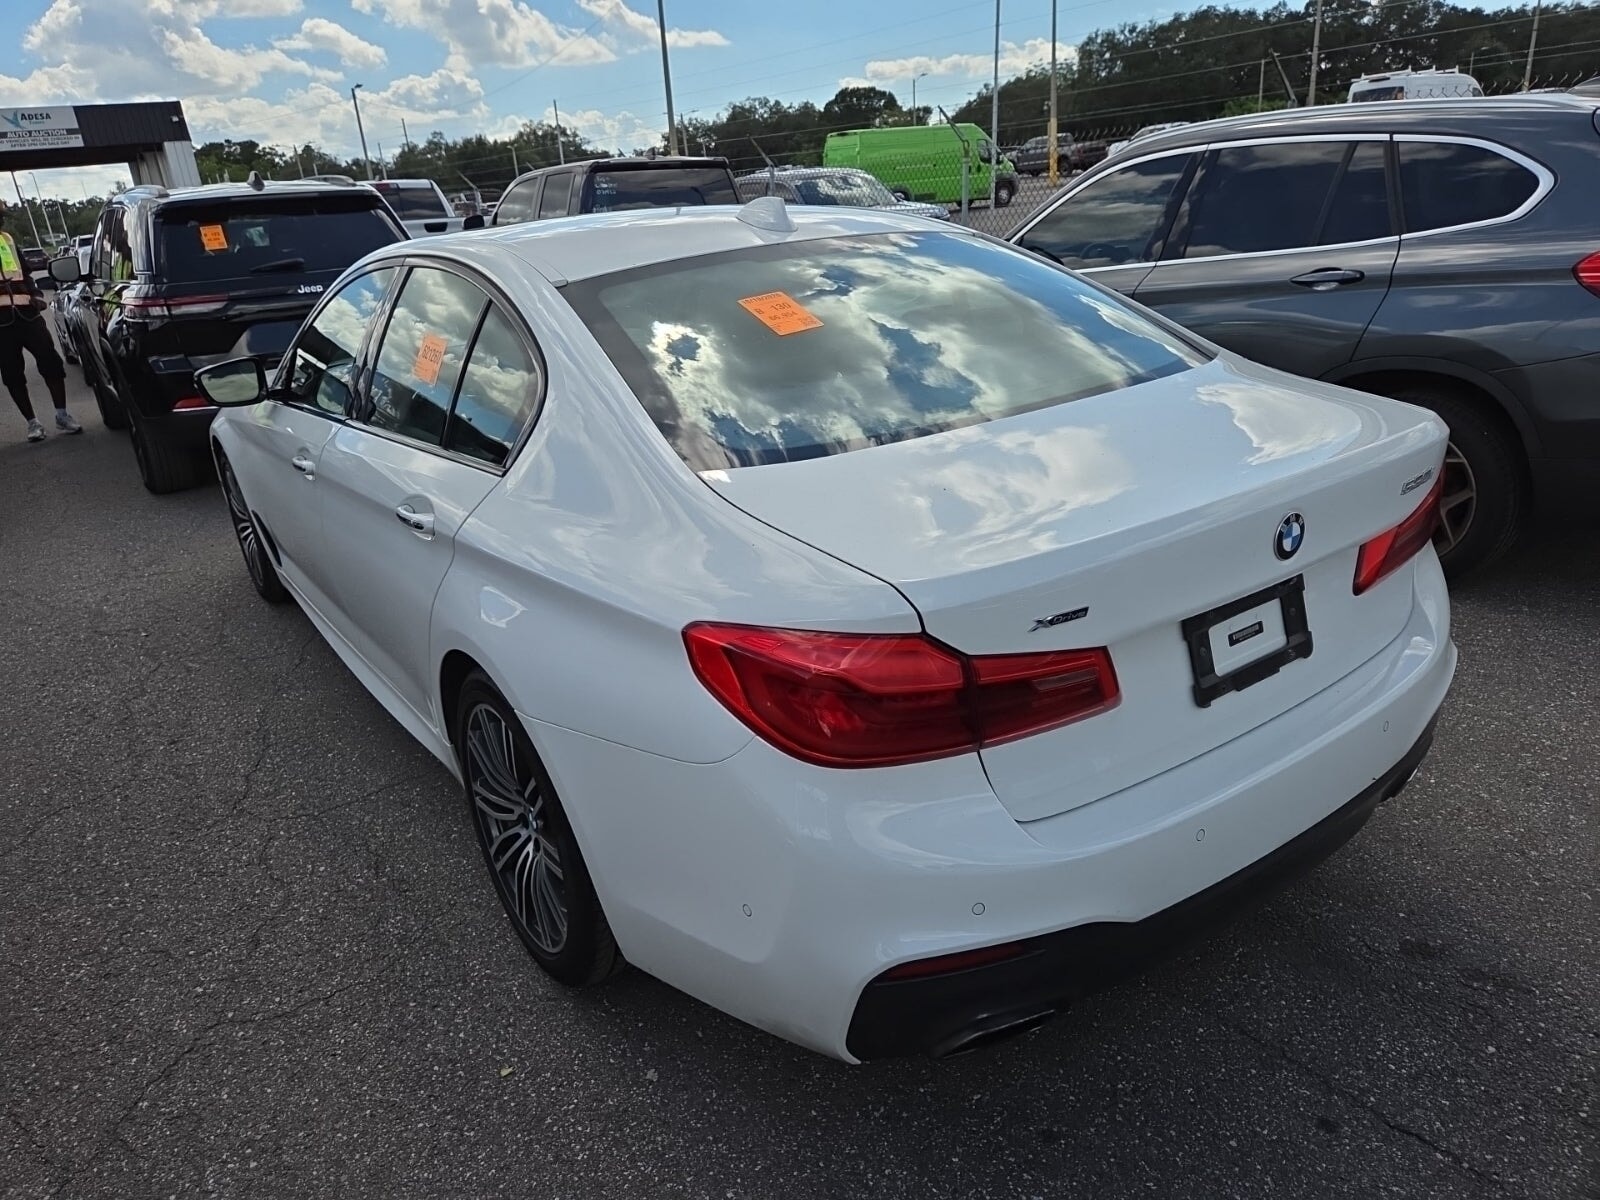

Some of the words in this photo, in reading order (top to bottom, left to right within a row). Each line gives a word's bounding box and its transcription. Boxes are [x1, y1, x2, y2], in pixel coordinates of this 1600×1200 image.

[21, 112, 52, 121] ADESA
[31, 129, 67, 137] AUCTION
[297, 284, 324, 294] Jeep
[770, 302, 792, 311] 130
